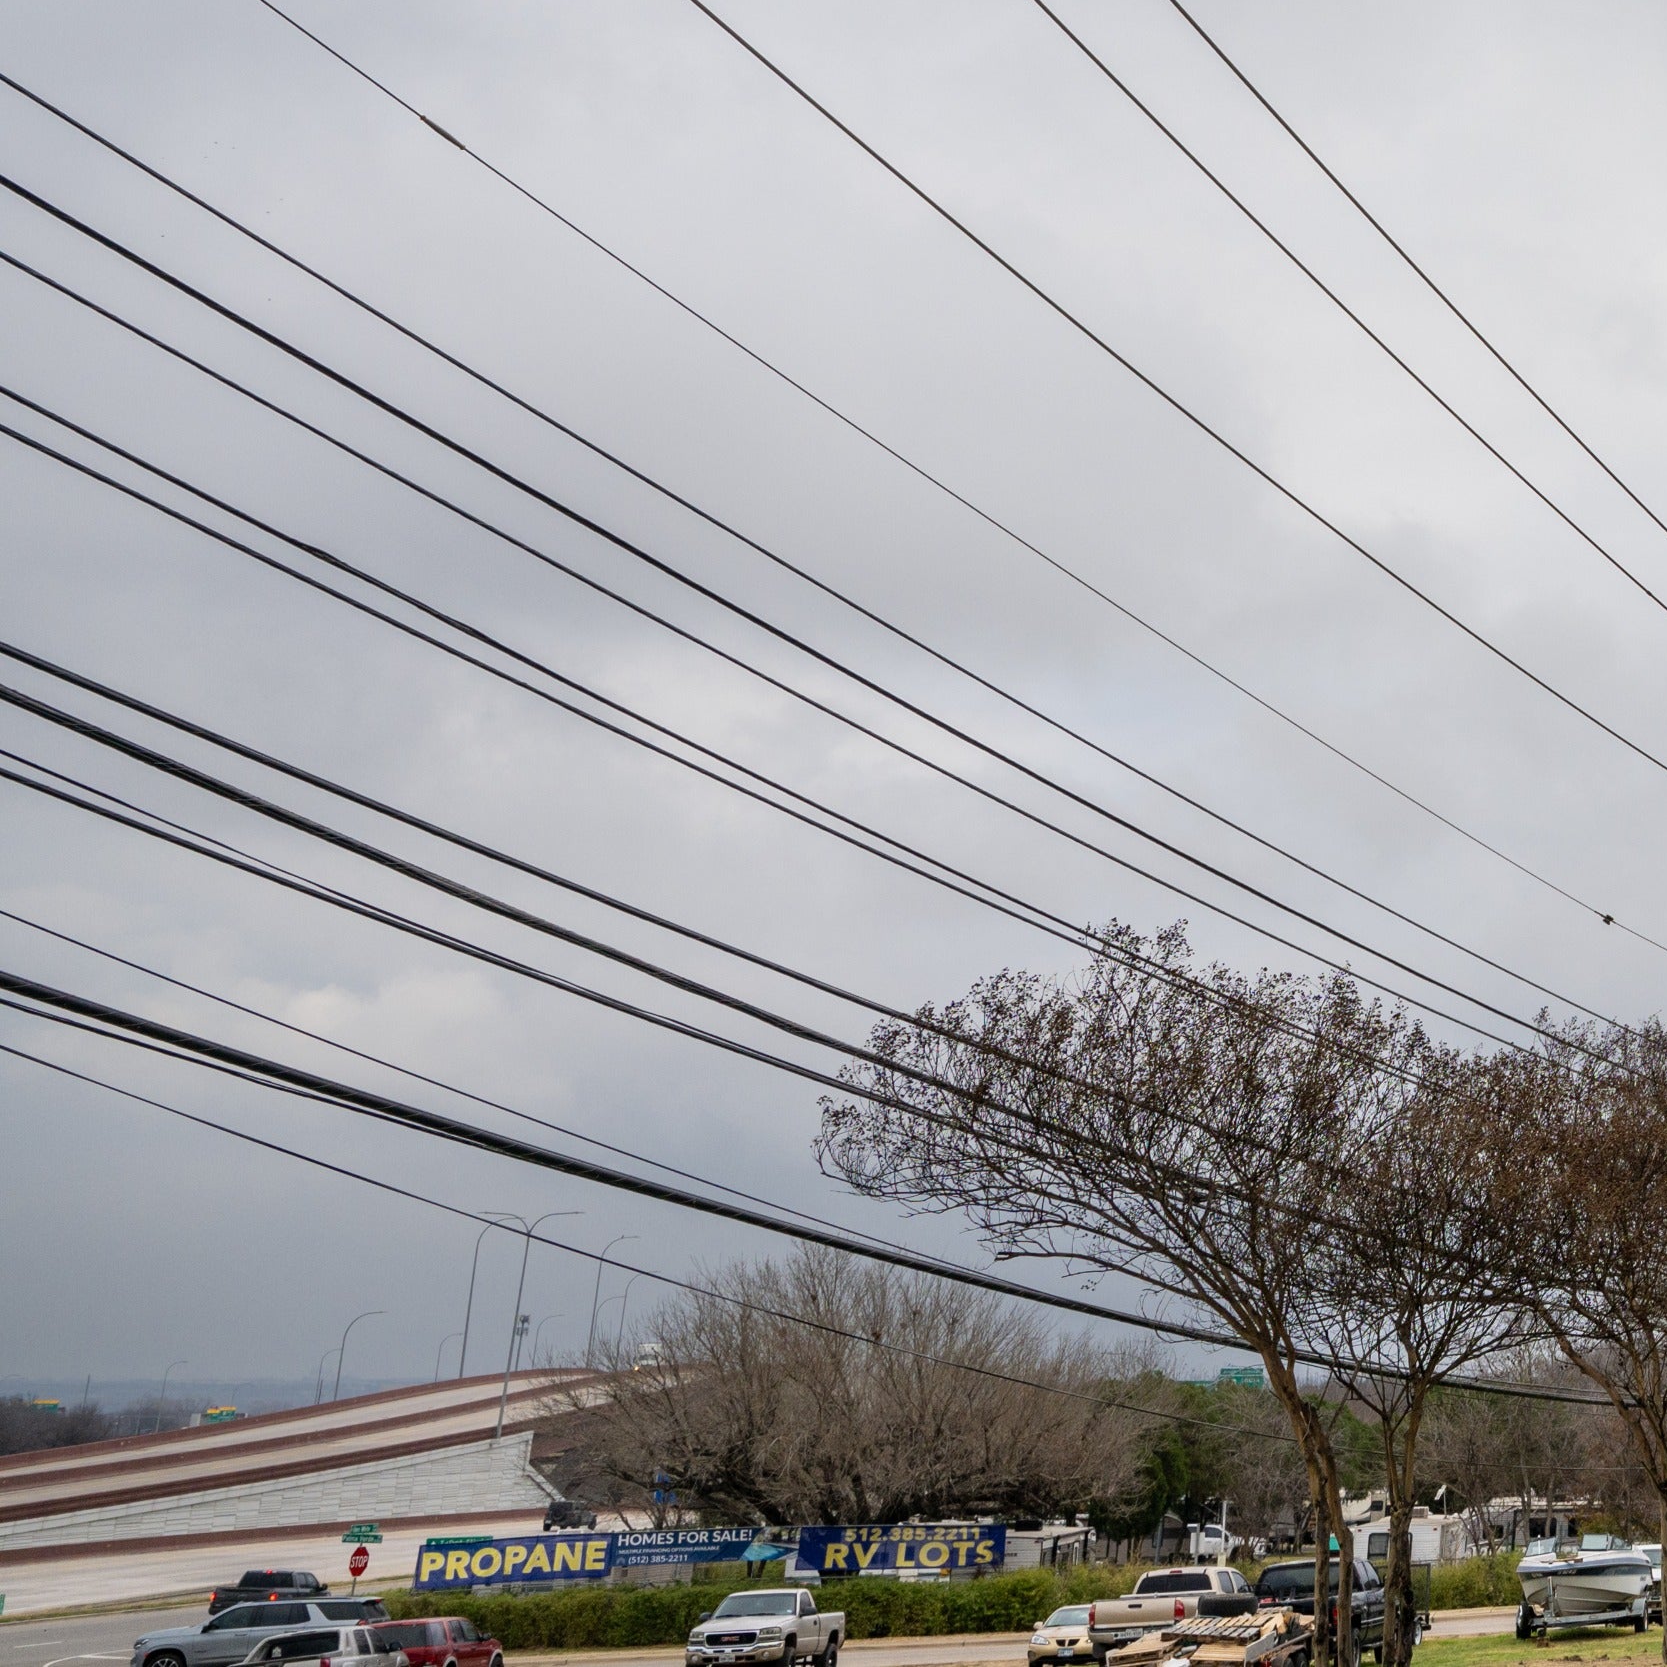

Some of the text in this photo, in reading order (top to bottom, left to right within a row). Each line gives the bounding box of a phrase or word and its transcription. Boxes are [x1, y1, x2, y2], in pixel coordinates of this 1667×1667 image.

[618, 1529, 752, 1546] HOMES FOR SALE!
[844, 1527, 980, 1542] 512.385.2211
[350, 1555, 368, 1569] STOP
[419, 1540, 607, 1582] PROPANE
[628, 1554, 688, 1565] (512) 385-2211
[824, 1540, 995, 1569] RV LOTS
